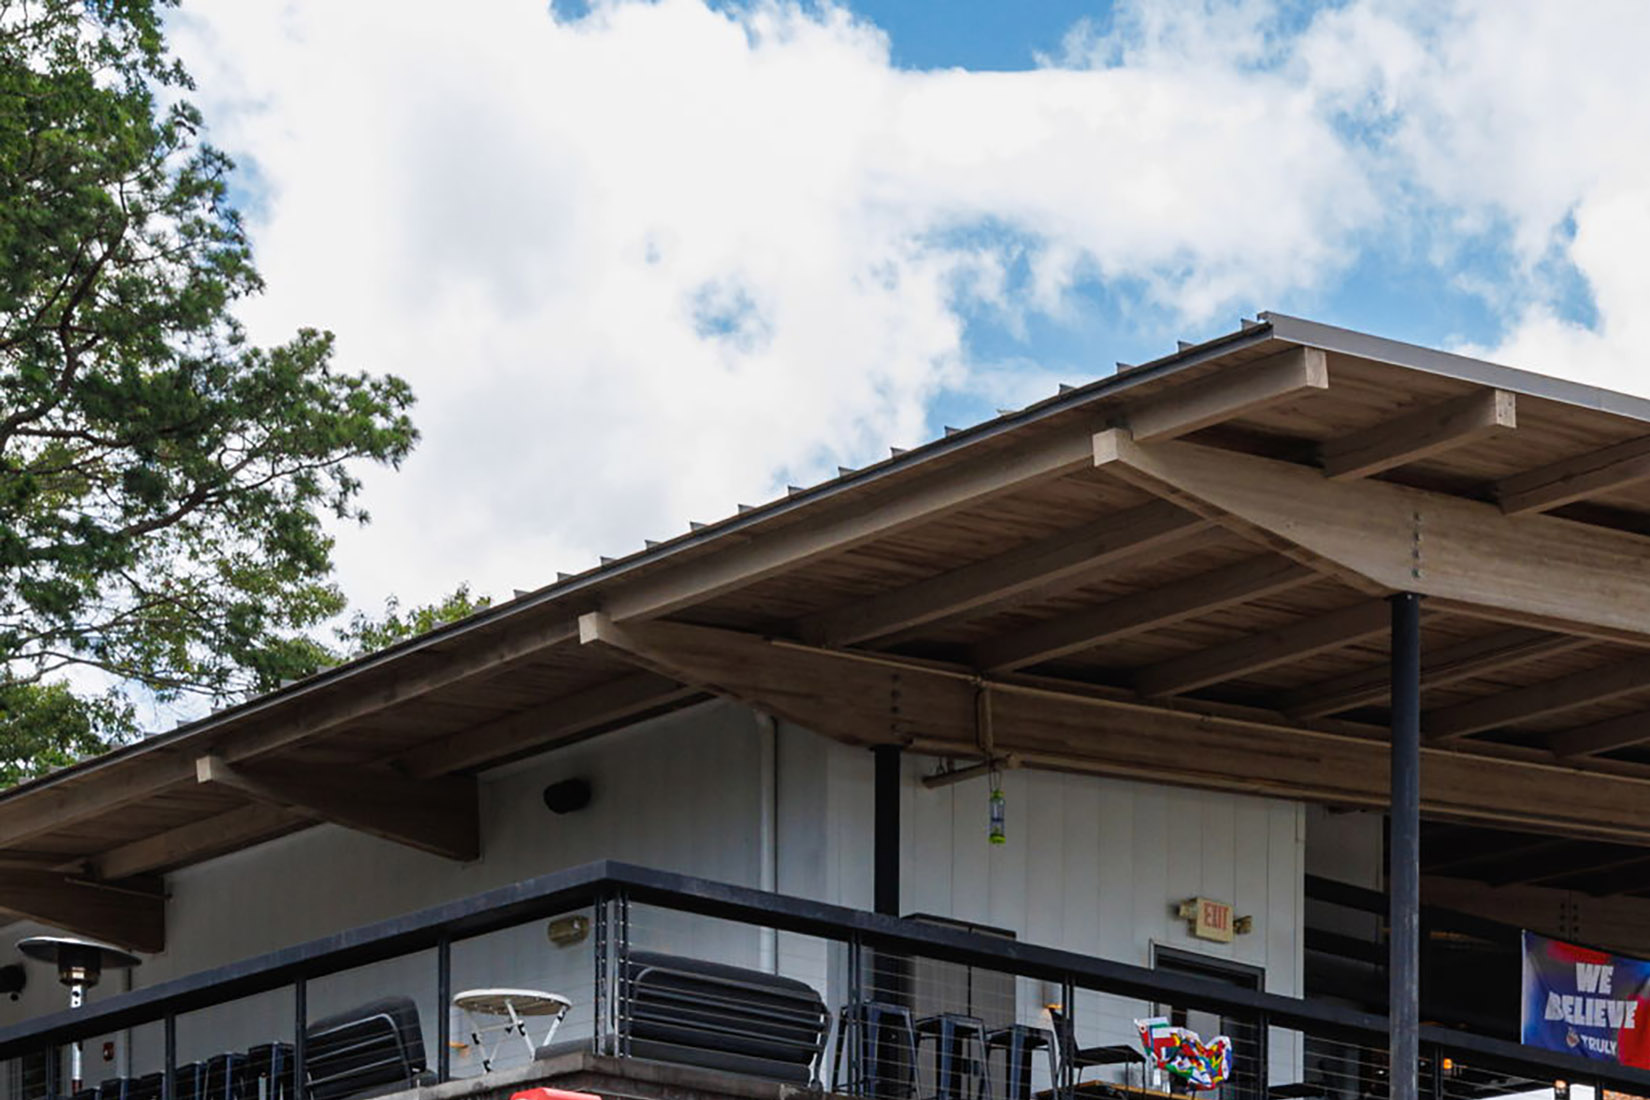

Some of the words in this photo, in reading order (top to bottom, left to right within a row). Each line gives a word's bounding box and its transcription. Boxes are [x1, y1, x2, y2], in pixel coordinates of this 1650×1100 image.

[1203, 902, 1229, 929] EXIT
[1576, 962, 1614, 995] WE
[1544, 991, 1638, 1029] BELIEVE
[1580, 1034, 1618, 1056] TRULY
